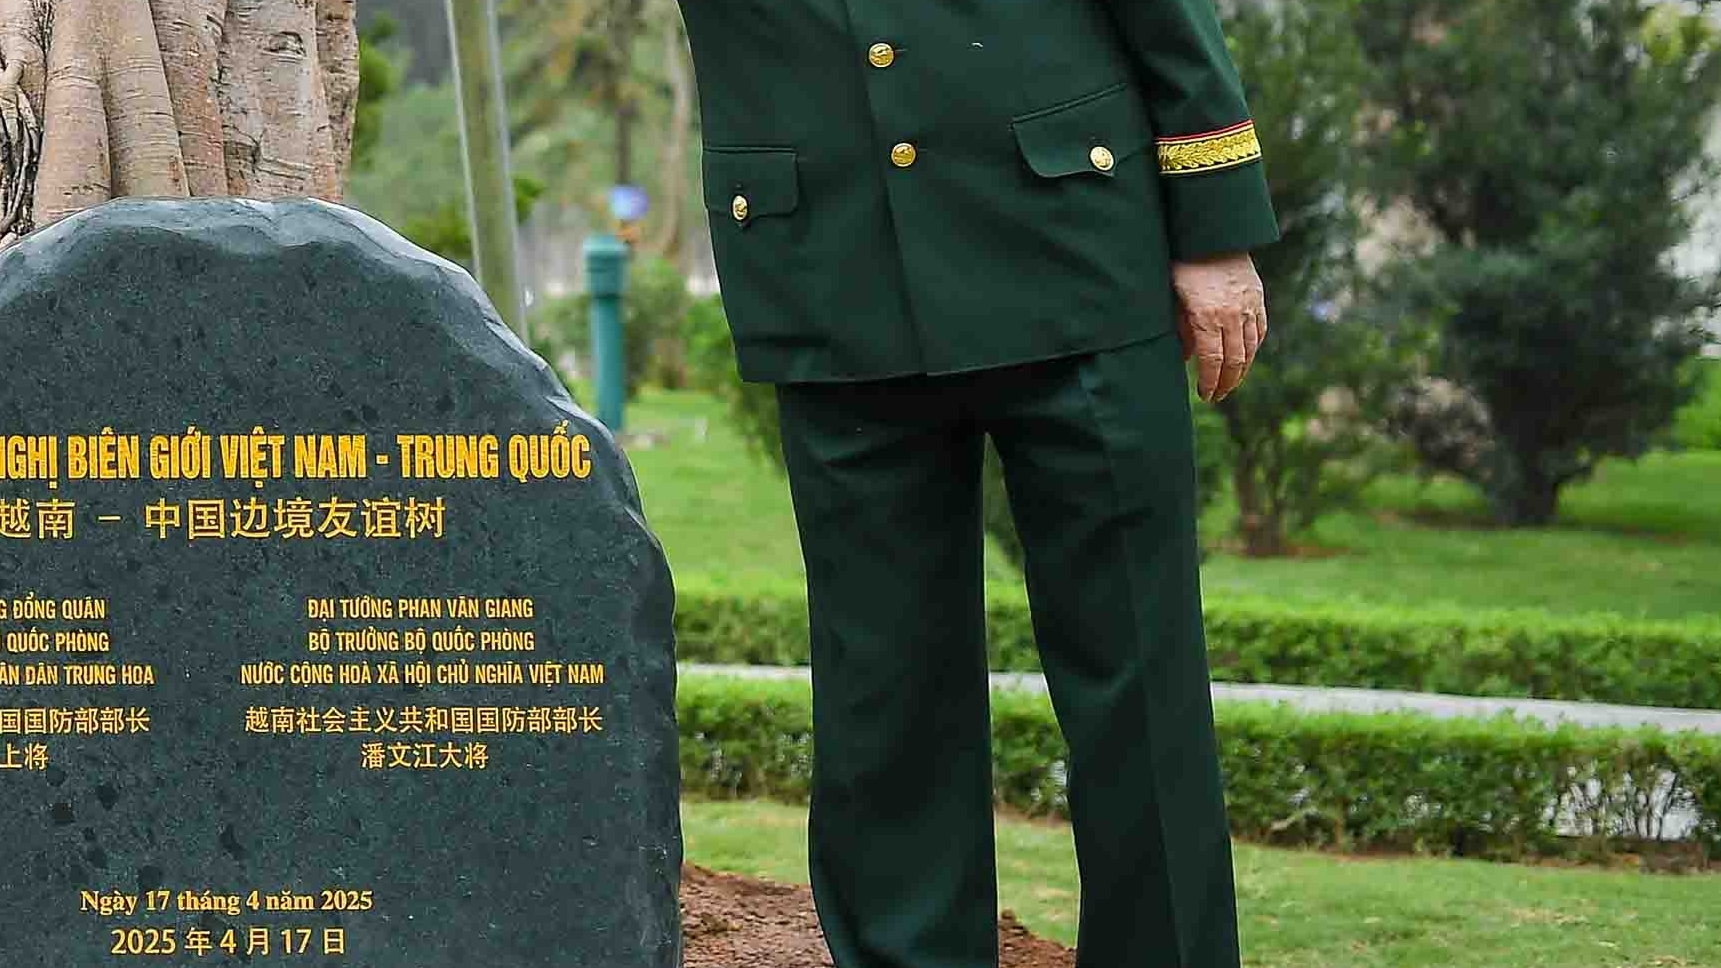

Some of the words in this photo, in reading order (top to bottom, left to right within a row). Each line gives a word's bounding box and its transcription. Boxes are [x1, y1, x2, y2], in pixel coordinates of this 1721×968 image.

[67, 426, 140, 479] BIÊN
[149, 426, 212, 480] GIỚI
[219, 425, 286, 489] VIỆT
[294, 434, 367, 479] NAM
[396, 433, 499, 479] TRUNG
[508, 420, 592, 483] QUỐC
[145, 496, 446, 540] 中国边境友谊树
[61, 597, 105, 620] QUÂN
[307, 598, 335, 622] ĐẠI
[341, 596, 393, 618] TƯỚNG
[398, 598, 442, 618] PHAN
[447, 596, 480, 618] VĂN
[484, 598, 534, 618] GIANG
[6, 627, 49, 652] QUỐC
[54, 629, 110, 652] PHÒNG
[308, 629, 330, 654] BỘ
[336, 627, 400, 651] TRƯỞNG
[404, 626, 427, 654] BỘ
[431, 625, 475, 652] QUỐC
[480, 629, 535, 651] PHÒNG
[24, 663, 59, 685] DÂN
[65, 664, 117, 685] TRUNG
[121, 665, 155, 684] HOA
[241, 662, 284, 684] NƯỚC
[290, 661, 334, 687] CỘNG
[339, 661, 372, 684] HOÀ
[378, 662, 400, 684] XÃ
[404, 662, 431, 687] HỘI
[436, 660, 469, 684] CHỦ
[475, 662, 524, 684] NGHĨA
[529, 659, 563, 687] VIỆT
[567, 663, 604, 684] NAM
[246, 706, 600, 733] 越南社会主义共和国国防部部长
[362, 742, 488, 768] 潘文江大将
[81, 890, 137, 916] Ngày
[147, 890, 171, 911] 17
[177, 890, 240, 916] tháng
[247, 890, 260, 910] 4
[265, 891, 315, 911] năm
[322, 889, 373, 910] 2025
[112, 928, 176, 955] 2025
[185, 926, 212, 955] 年
[219, 930, 237, 954] 4
[248, 928, 269, 955] 月
[281, 928, 312, 954] 17
[323, 928, 344, 954] 日
